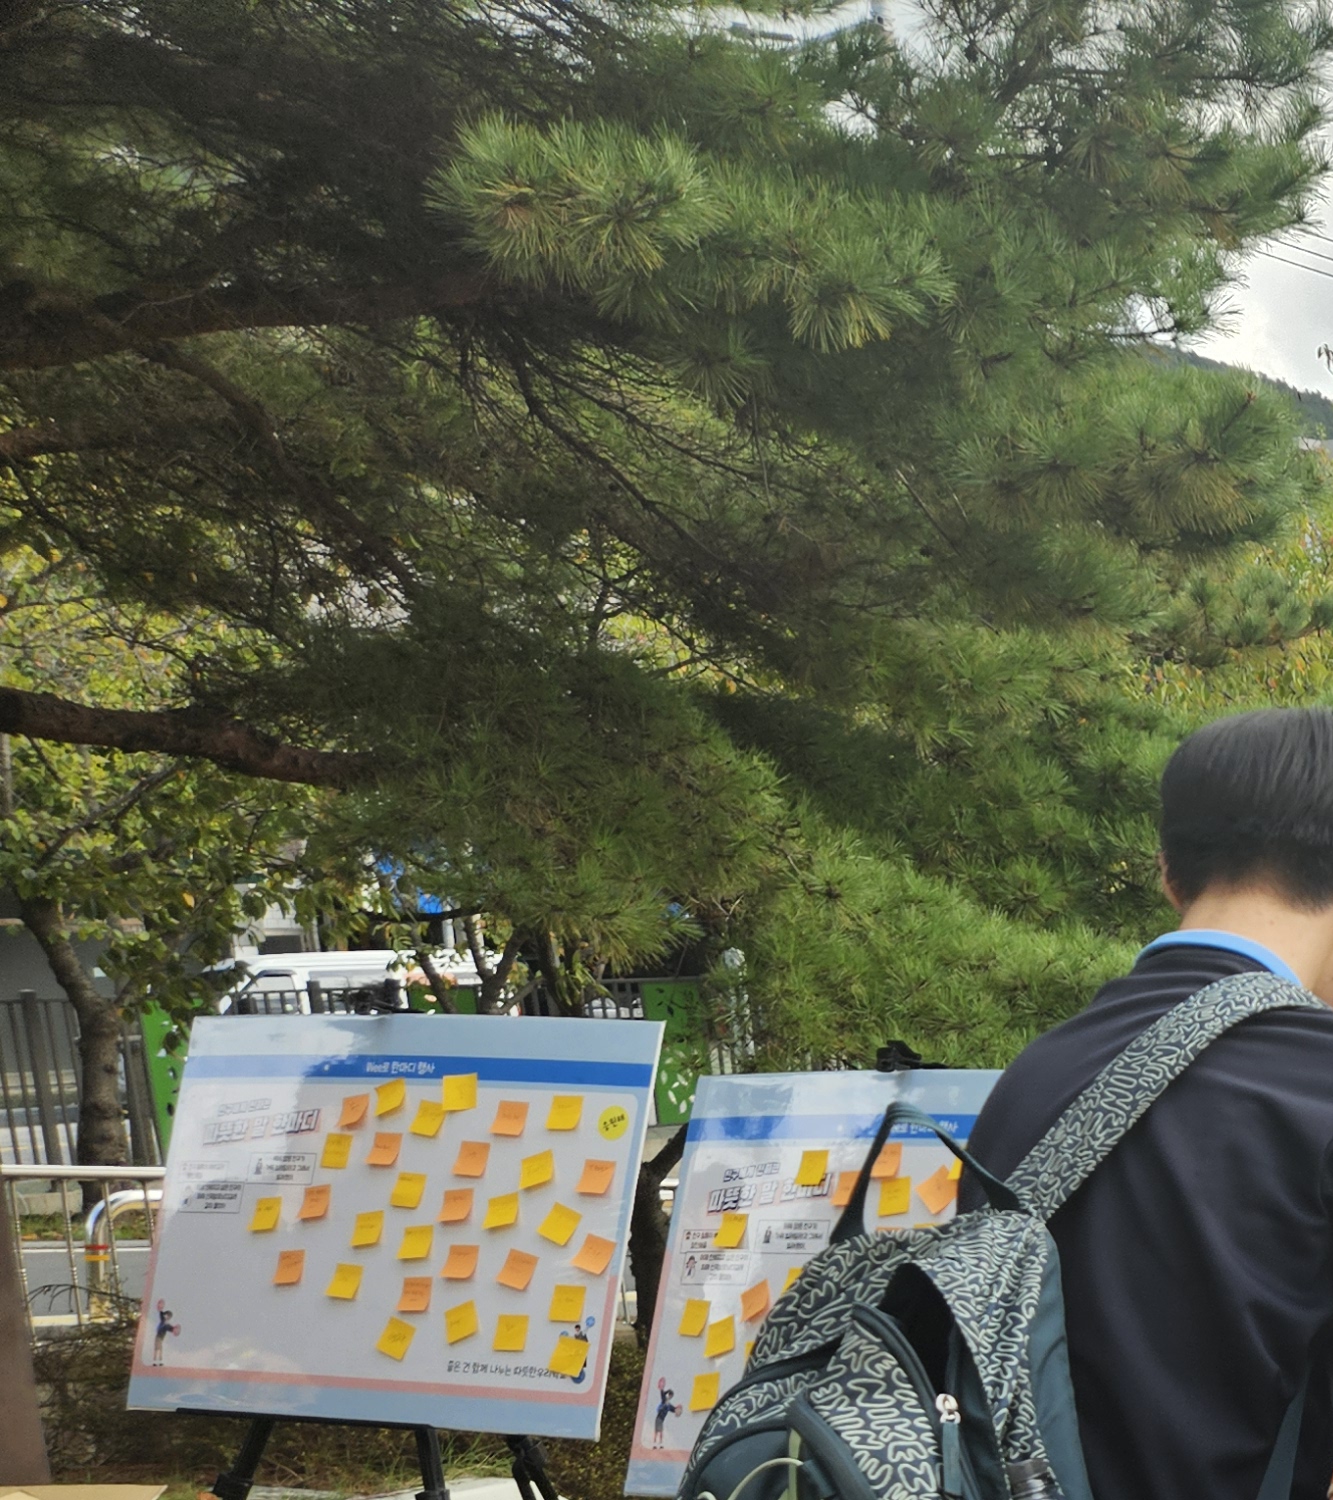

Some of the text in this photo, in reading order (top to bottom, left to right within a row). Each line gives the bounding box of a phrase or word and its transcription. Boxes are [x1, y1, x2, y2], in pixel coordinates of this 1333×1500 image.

[252, 1115, 270, 1139] 말
[271, 1109, 320, 1136] 한마디
[708, 1184, 756, 1212] 따뜻한
[759, 1180, 778, 1205] 말
